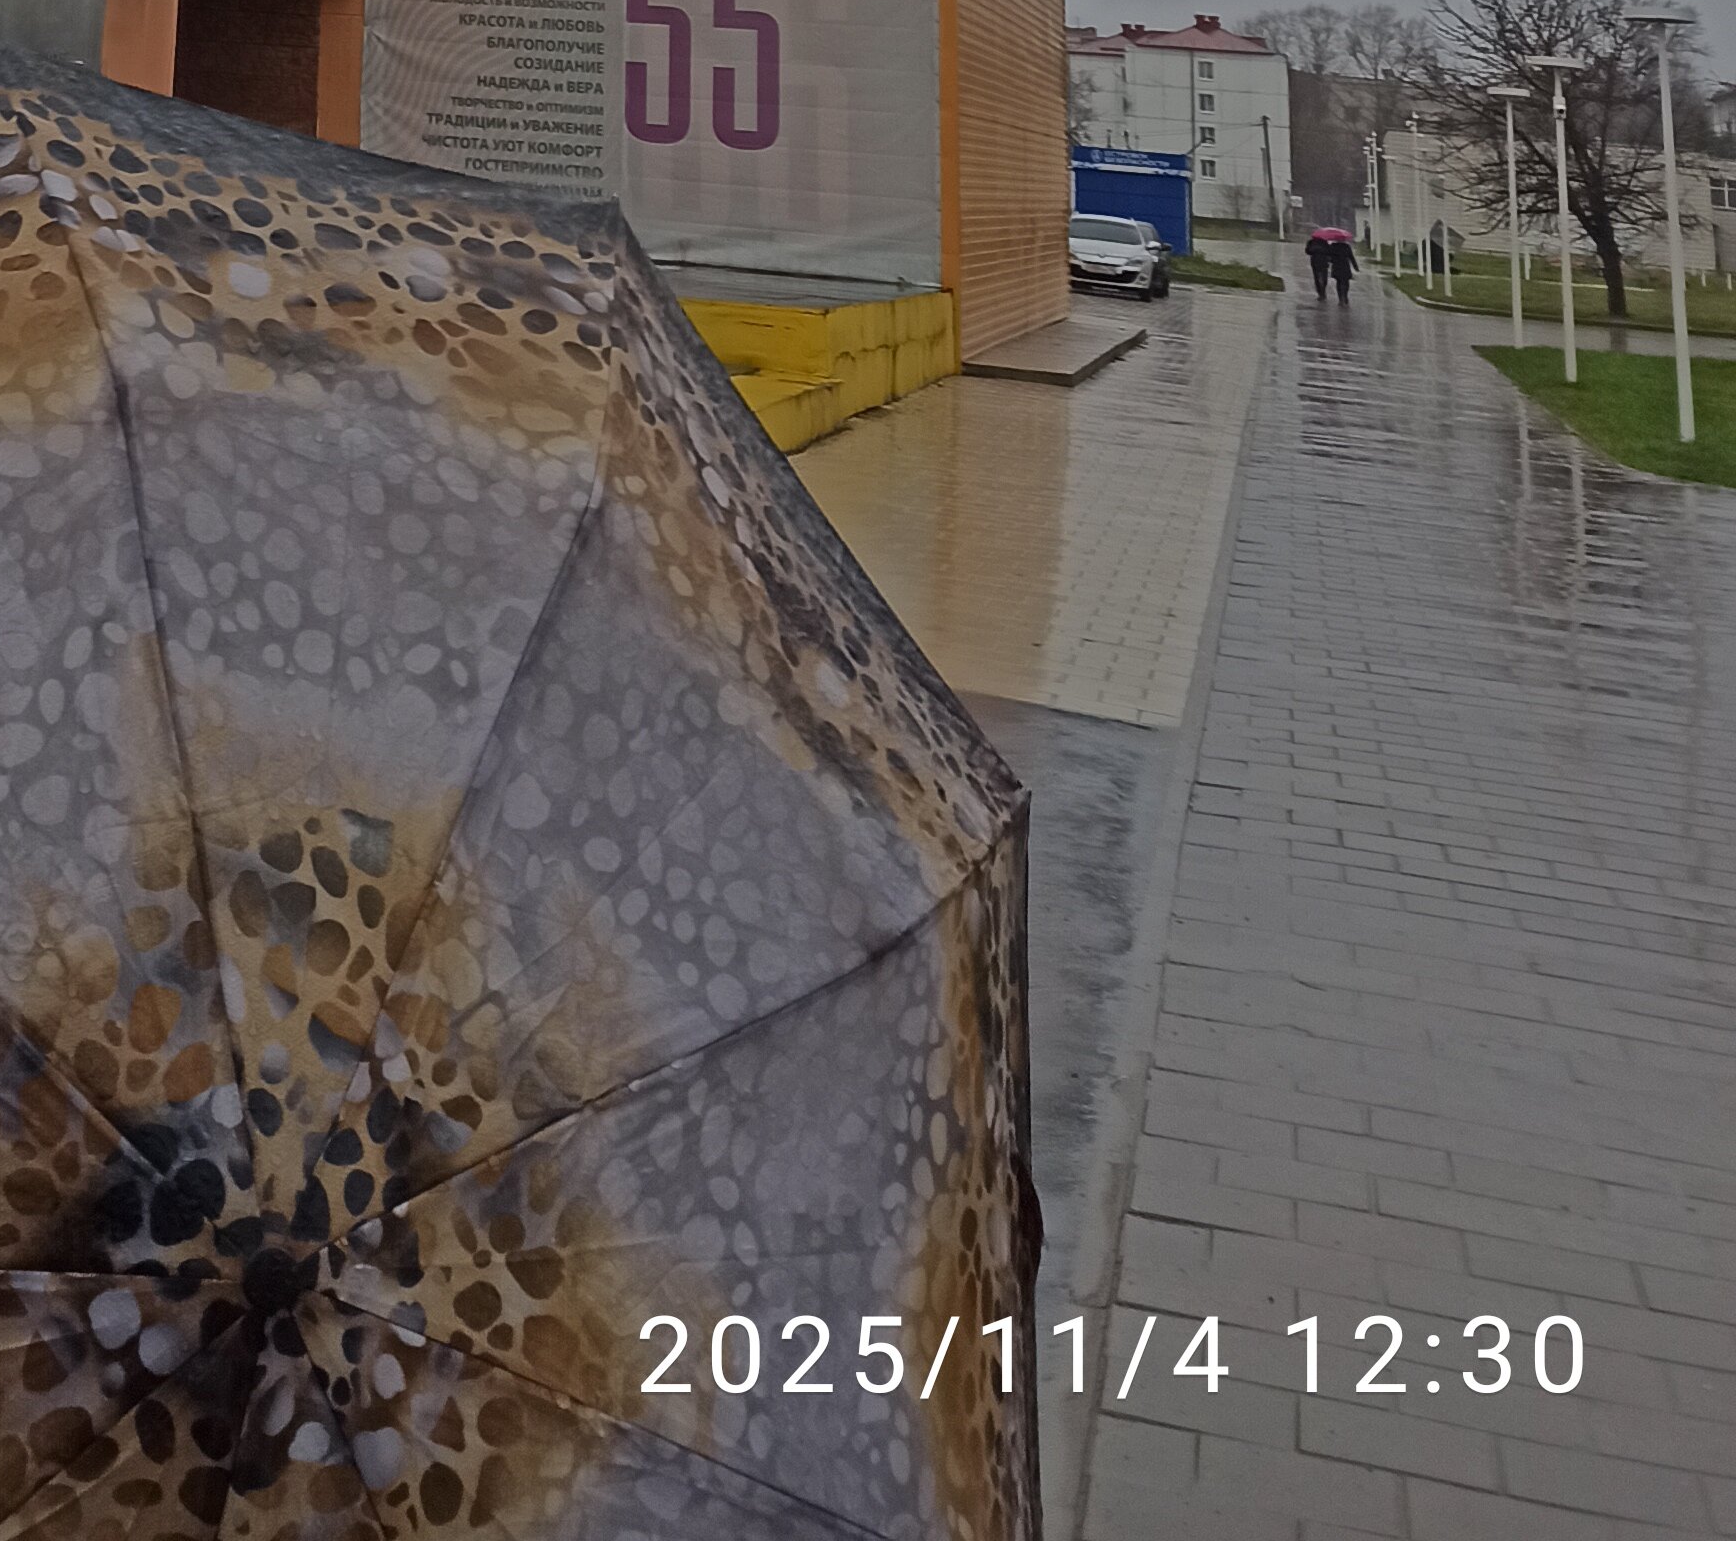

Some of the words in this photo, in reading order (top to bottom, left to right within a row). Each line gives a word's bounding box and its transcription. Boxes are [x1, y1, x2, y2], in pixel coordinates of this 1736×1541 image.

[458, 14, 525, 29] КРАСОТА
[540, 18, 605, 34] ЛЮБОВЬ
[486, 36, 605, 55] БЛАГОПОЛУЧИЕ
[514, 57, 605, 74] СОЗИДАНИЕ
[477, 75, 550, 92] НАДЕЖДА
[567, 81, 604, 95] ВЕРА
[451, 96, 524, 110] ТВОРЧЕСТВО
[536, 102, 604, 116] ОПТИМИЗМ
[426, 112, 507, 129] ТРАДИЦИИ
[522, 119, 604, 136] УВАЖЕНИЕ
[421, 134, 489, 151] ЧИСТОТА
[492, 139, 525, 153] УЮТ
[528, 141, 604, 158] КОМФОРТ
[465, 157, 604, 179] ГОСТЕПРИИМСТВО
